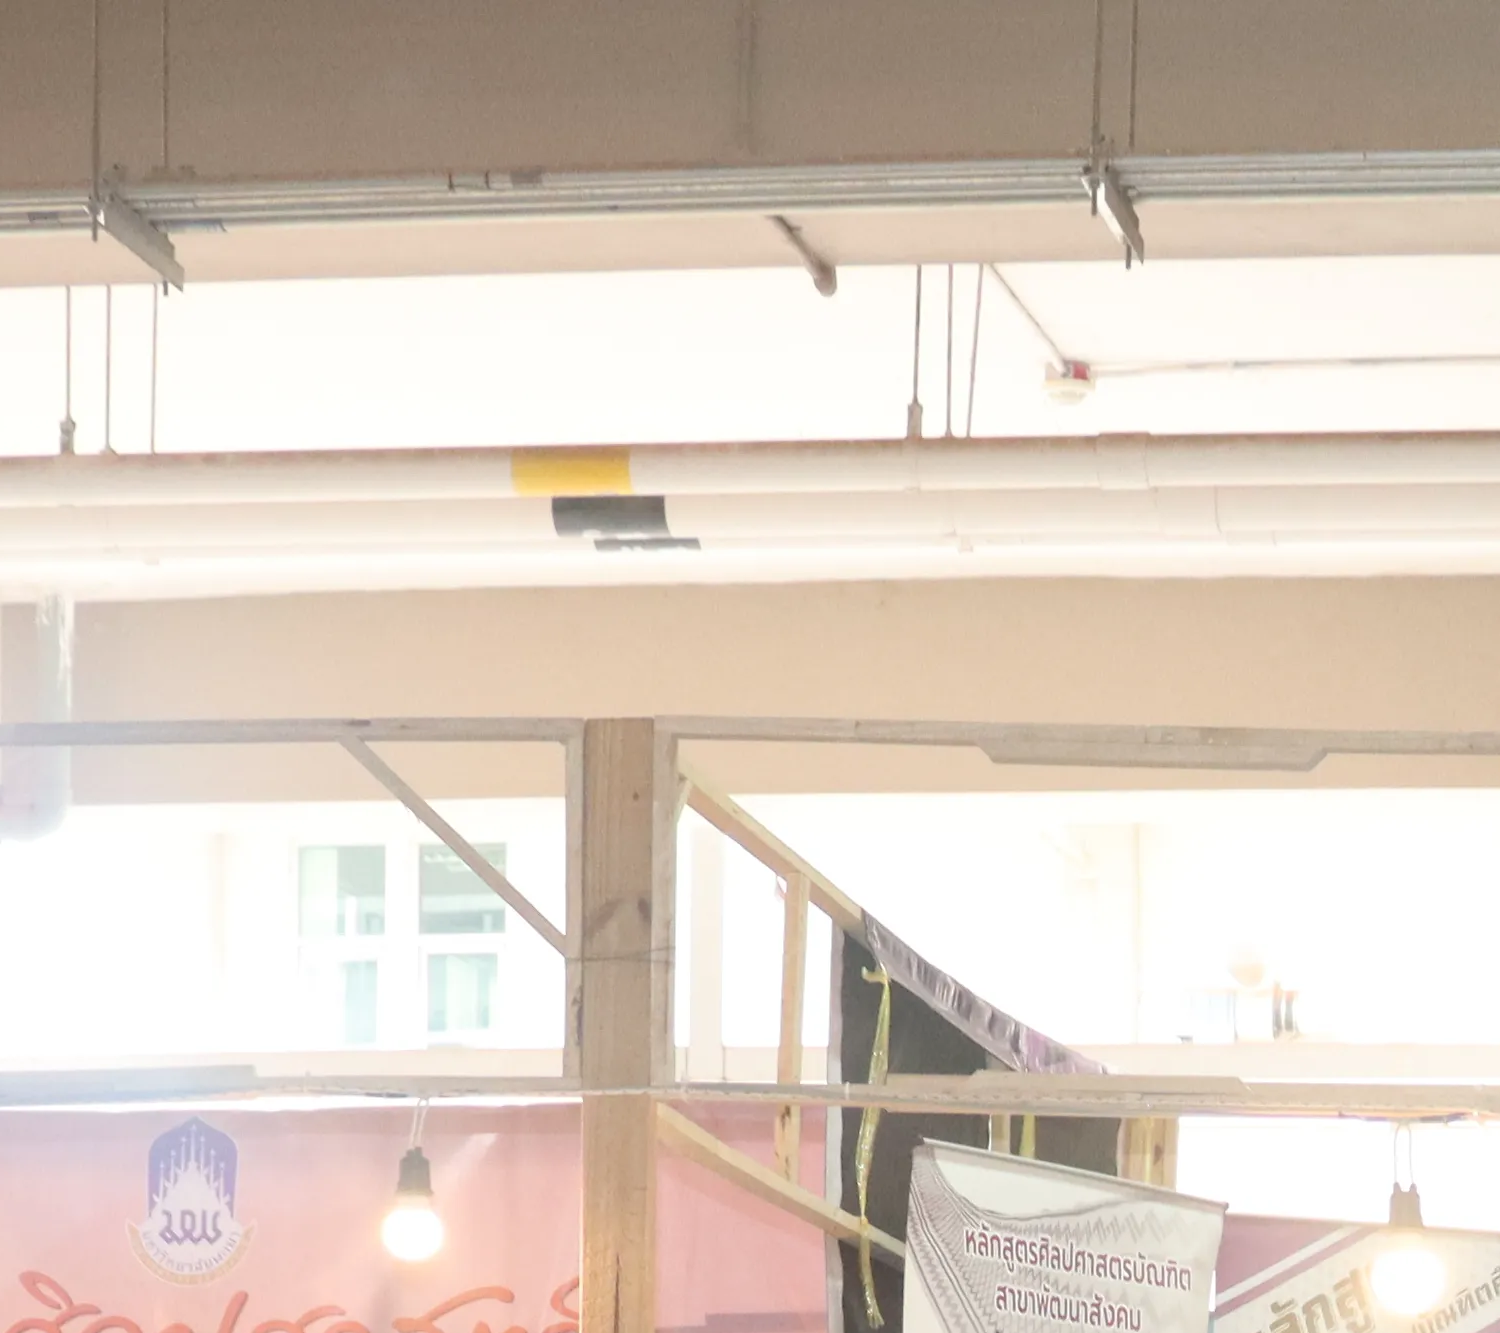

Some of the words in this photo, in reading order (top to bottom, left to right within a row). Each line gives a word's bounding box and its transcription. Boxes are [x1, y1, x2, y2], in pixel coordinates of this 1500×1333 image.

[965, 1220, 1192, 1292] หลักสูตรศิลปศาสตรบัณฑิต
[995, 1285, 1142, 1333] สาขาพัฒนาสังคม
